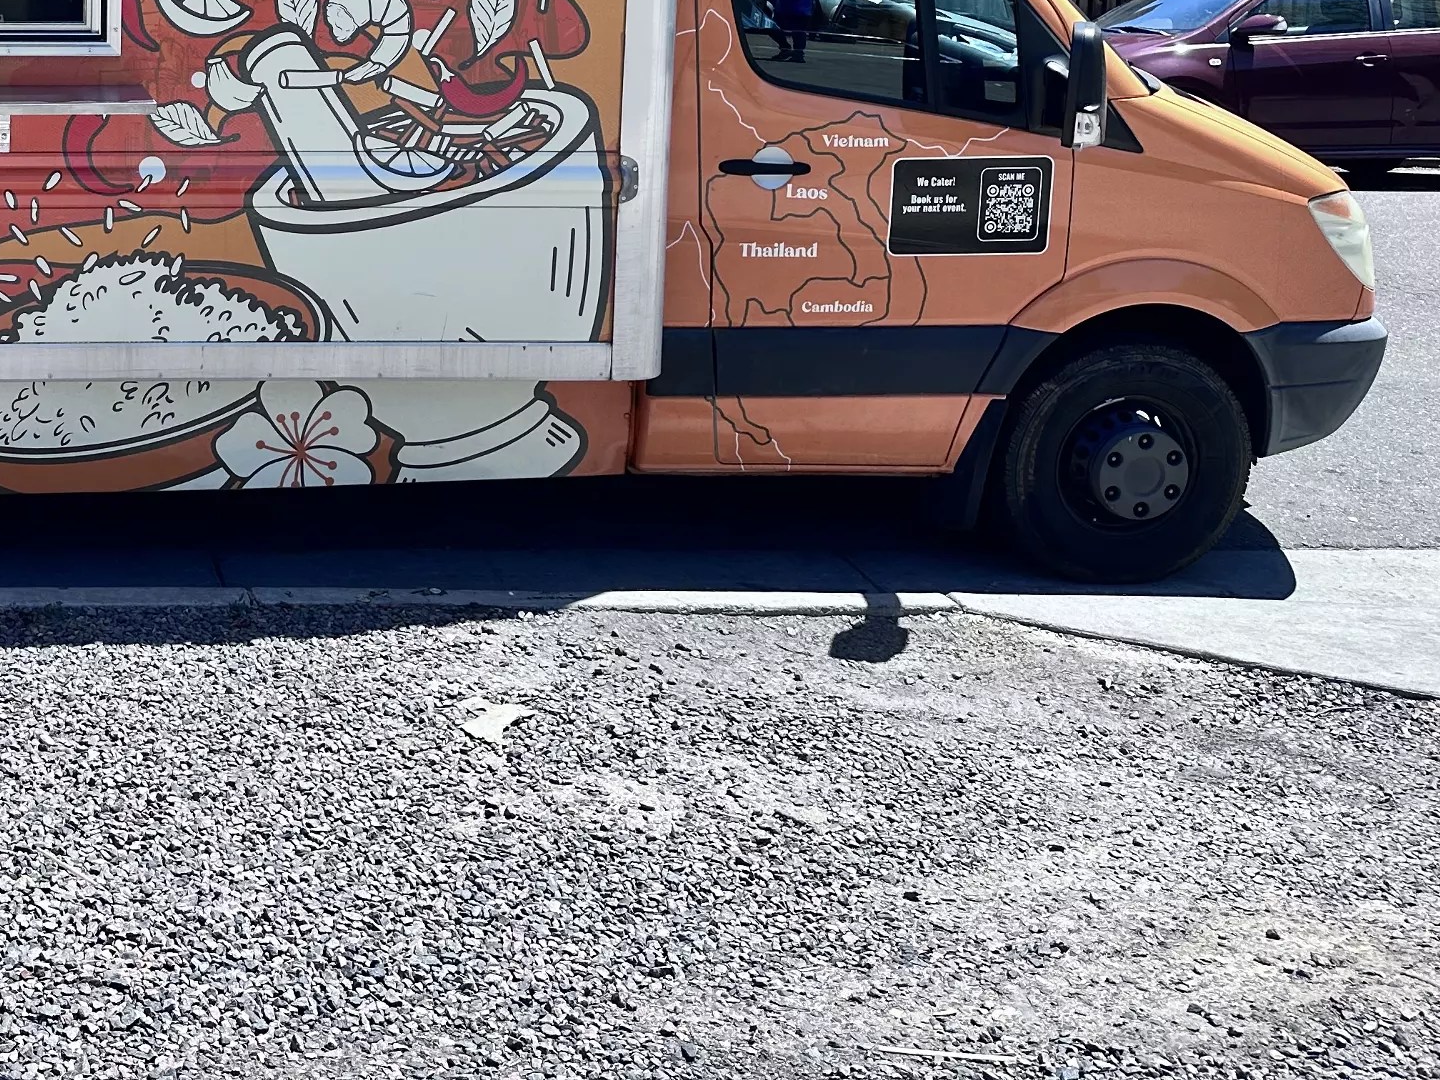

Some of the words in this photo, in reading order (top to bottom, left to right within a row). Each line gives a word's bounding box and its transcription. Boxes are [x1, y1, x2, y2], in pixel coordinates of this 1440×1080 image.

[822, 134, 889, 148] Vietnam
[917, 177, 929, 187] We
[931, 176, 956, 187] Cater!
[998, 173, 1015, 181] SCAN
[1016, 172, 1026, 180] ME
[786, 184, 828, 200] Laos
[911, 194, 931, 204] Book
[934, 195, 943, 204] us
[946, 194, 958, 203] for
[903, 205, 921, 214] your
[923, 204, 941, 213] next
[942, 203, 967, 212] event.
[739, 242, 818, 258] Thailand
[801, 300, 873, 313] Cambodia
